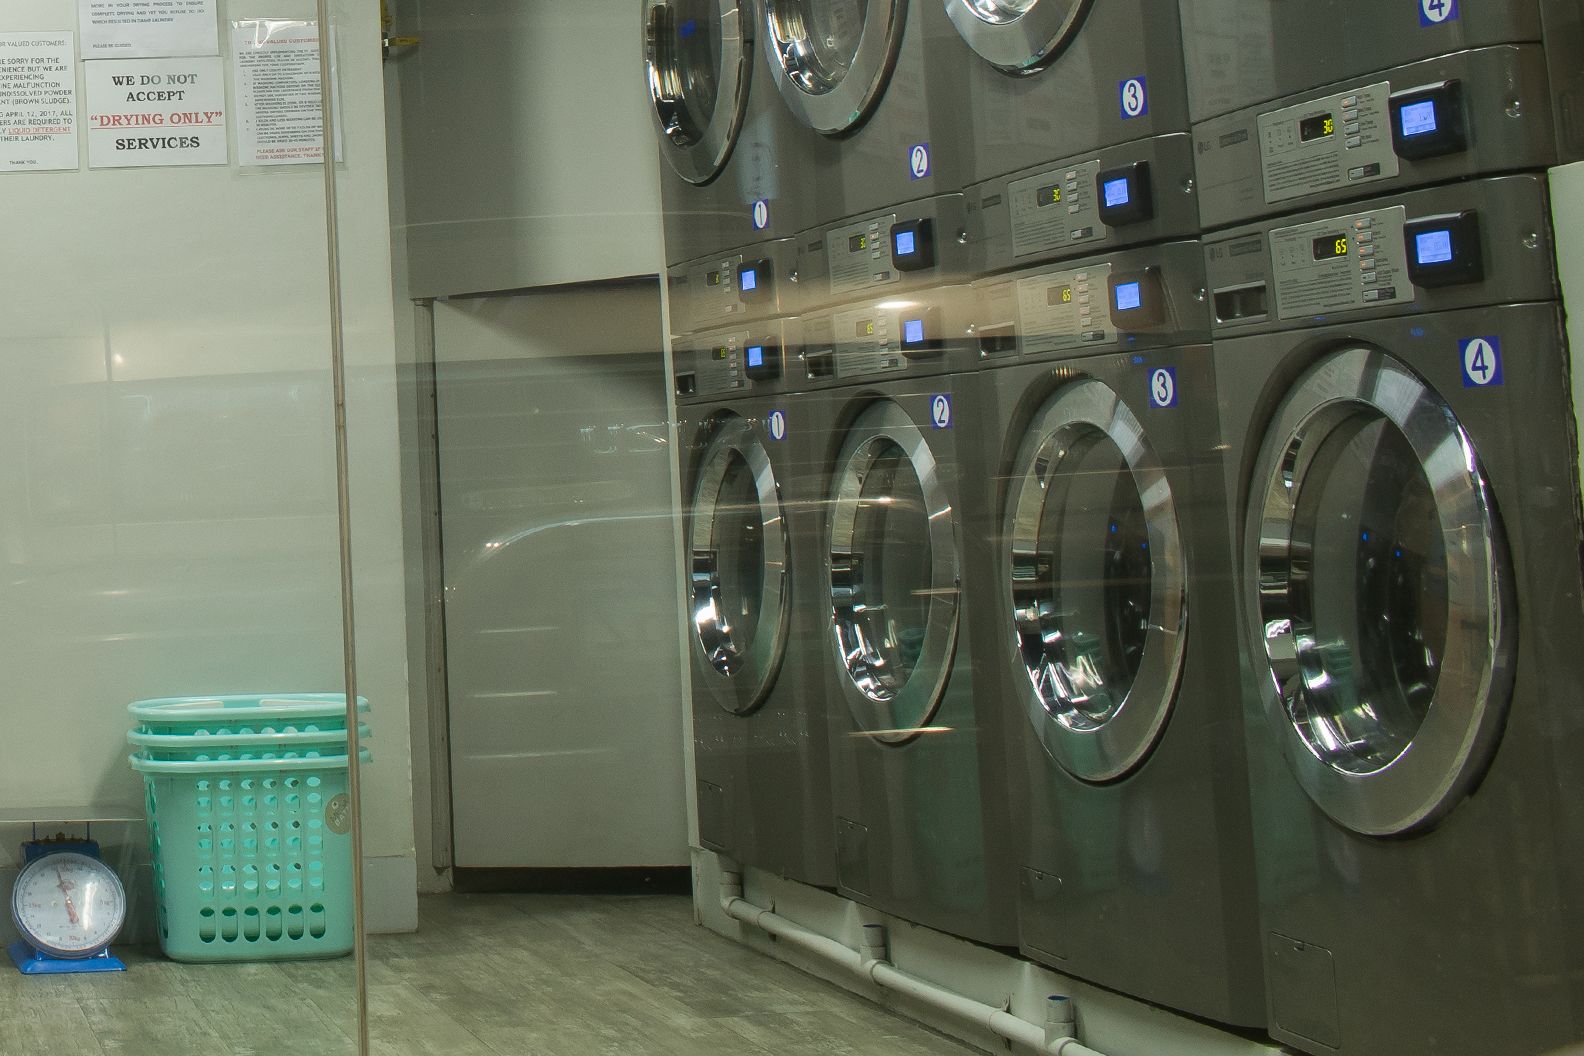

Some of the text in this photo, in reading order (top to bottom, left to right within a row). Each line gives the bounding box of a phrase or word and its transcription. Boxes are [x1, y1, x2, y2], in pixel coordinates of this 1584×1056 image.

[112, 74, 197, 86] WE DO NOT
[12, 98, 39, 106] (BROWN
[126, 90, 185, 102] ACCEPT
[1127, 82, 1137, 112] 3
[116, 136, 200, 150] SERVICES
[915, 147, 924, 173] 2
[1335, 238, 1347, 254] 65
[1062, 289, 1071, 302] 65
[1471, 342, 1489, 381] 4
[1156, 371, 1168, 404] 3
[936, 398, 946, 424] 2
